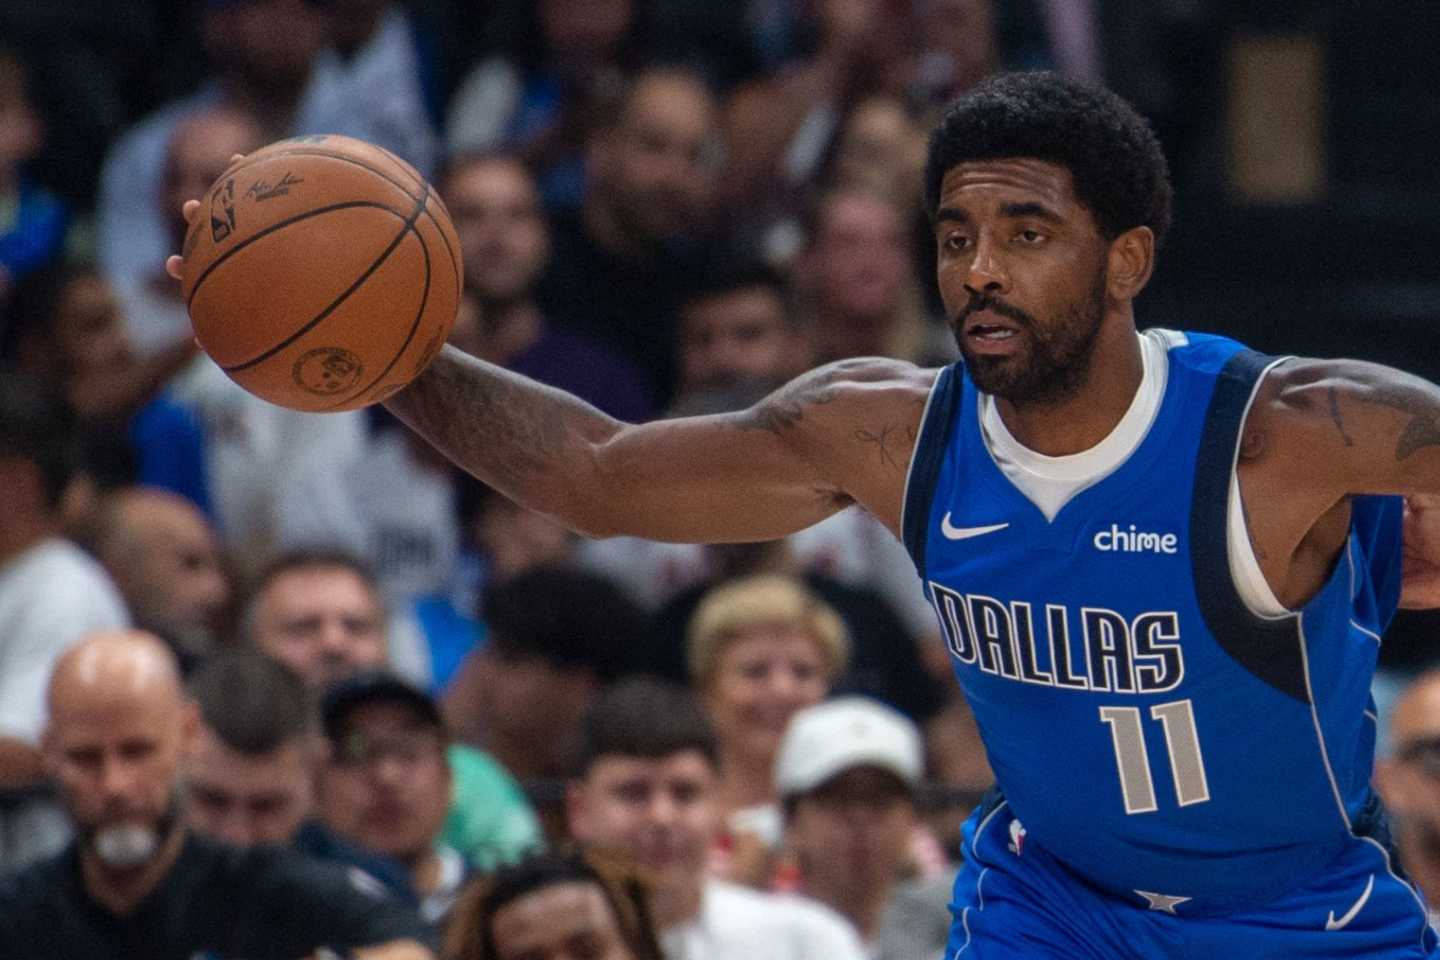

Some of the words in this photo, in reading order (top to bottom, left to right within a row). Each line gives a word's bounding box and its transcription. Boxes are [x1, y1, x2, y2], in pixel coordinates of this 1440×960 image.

[1093, 523, 1178, 554] chime
[928, 580, 1185, 694] DALLAS
[1099, 699, 1209, 815] 11
